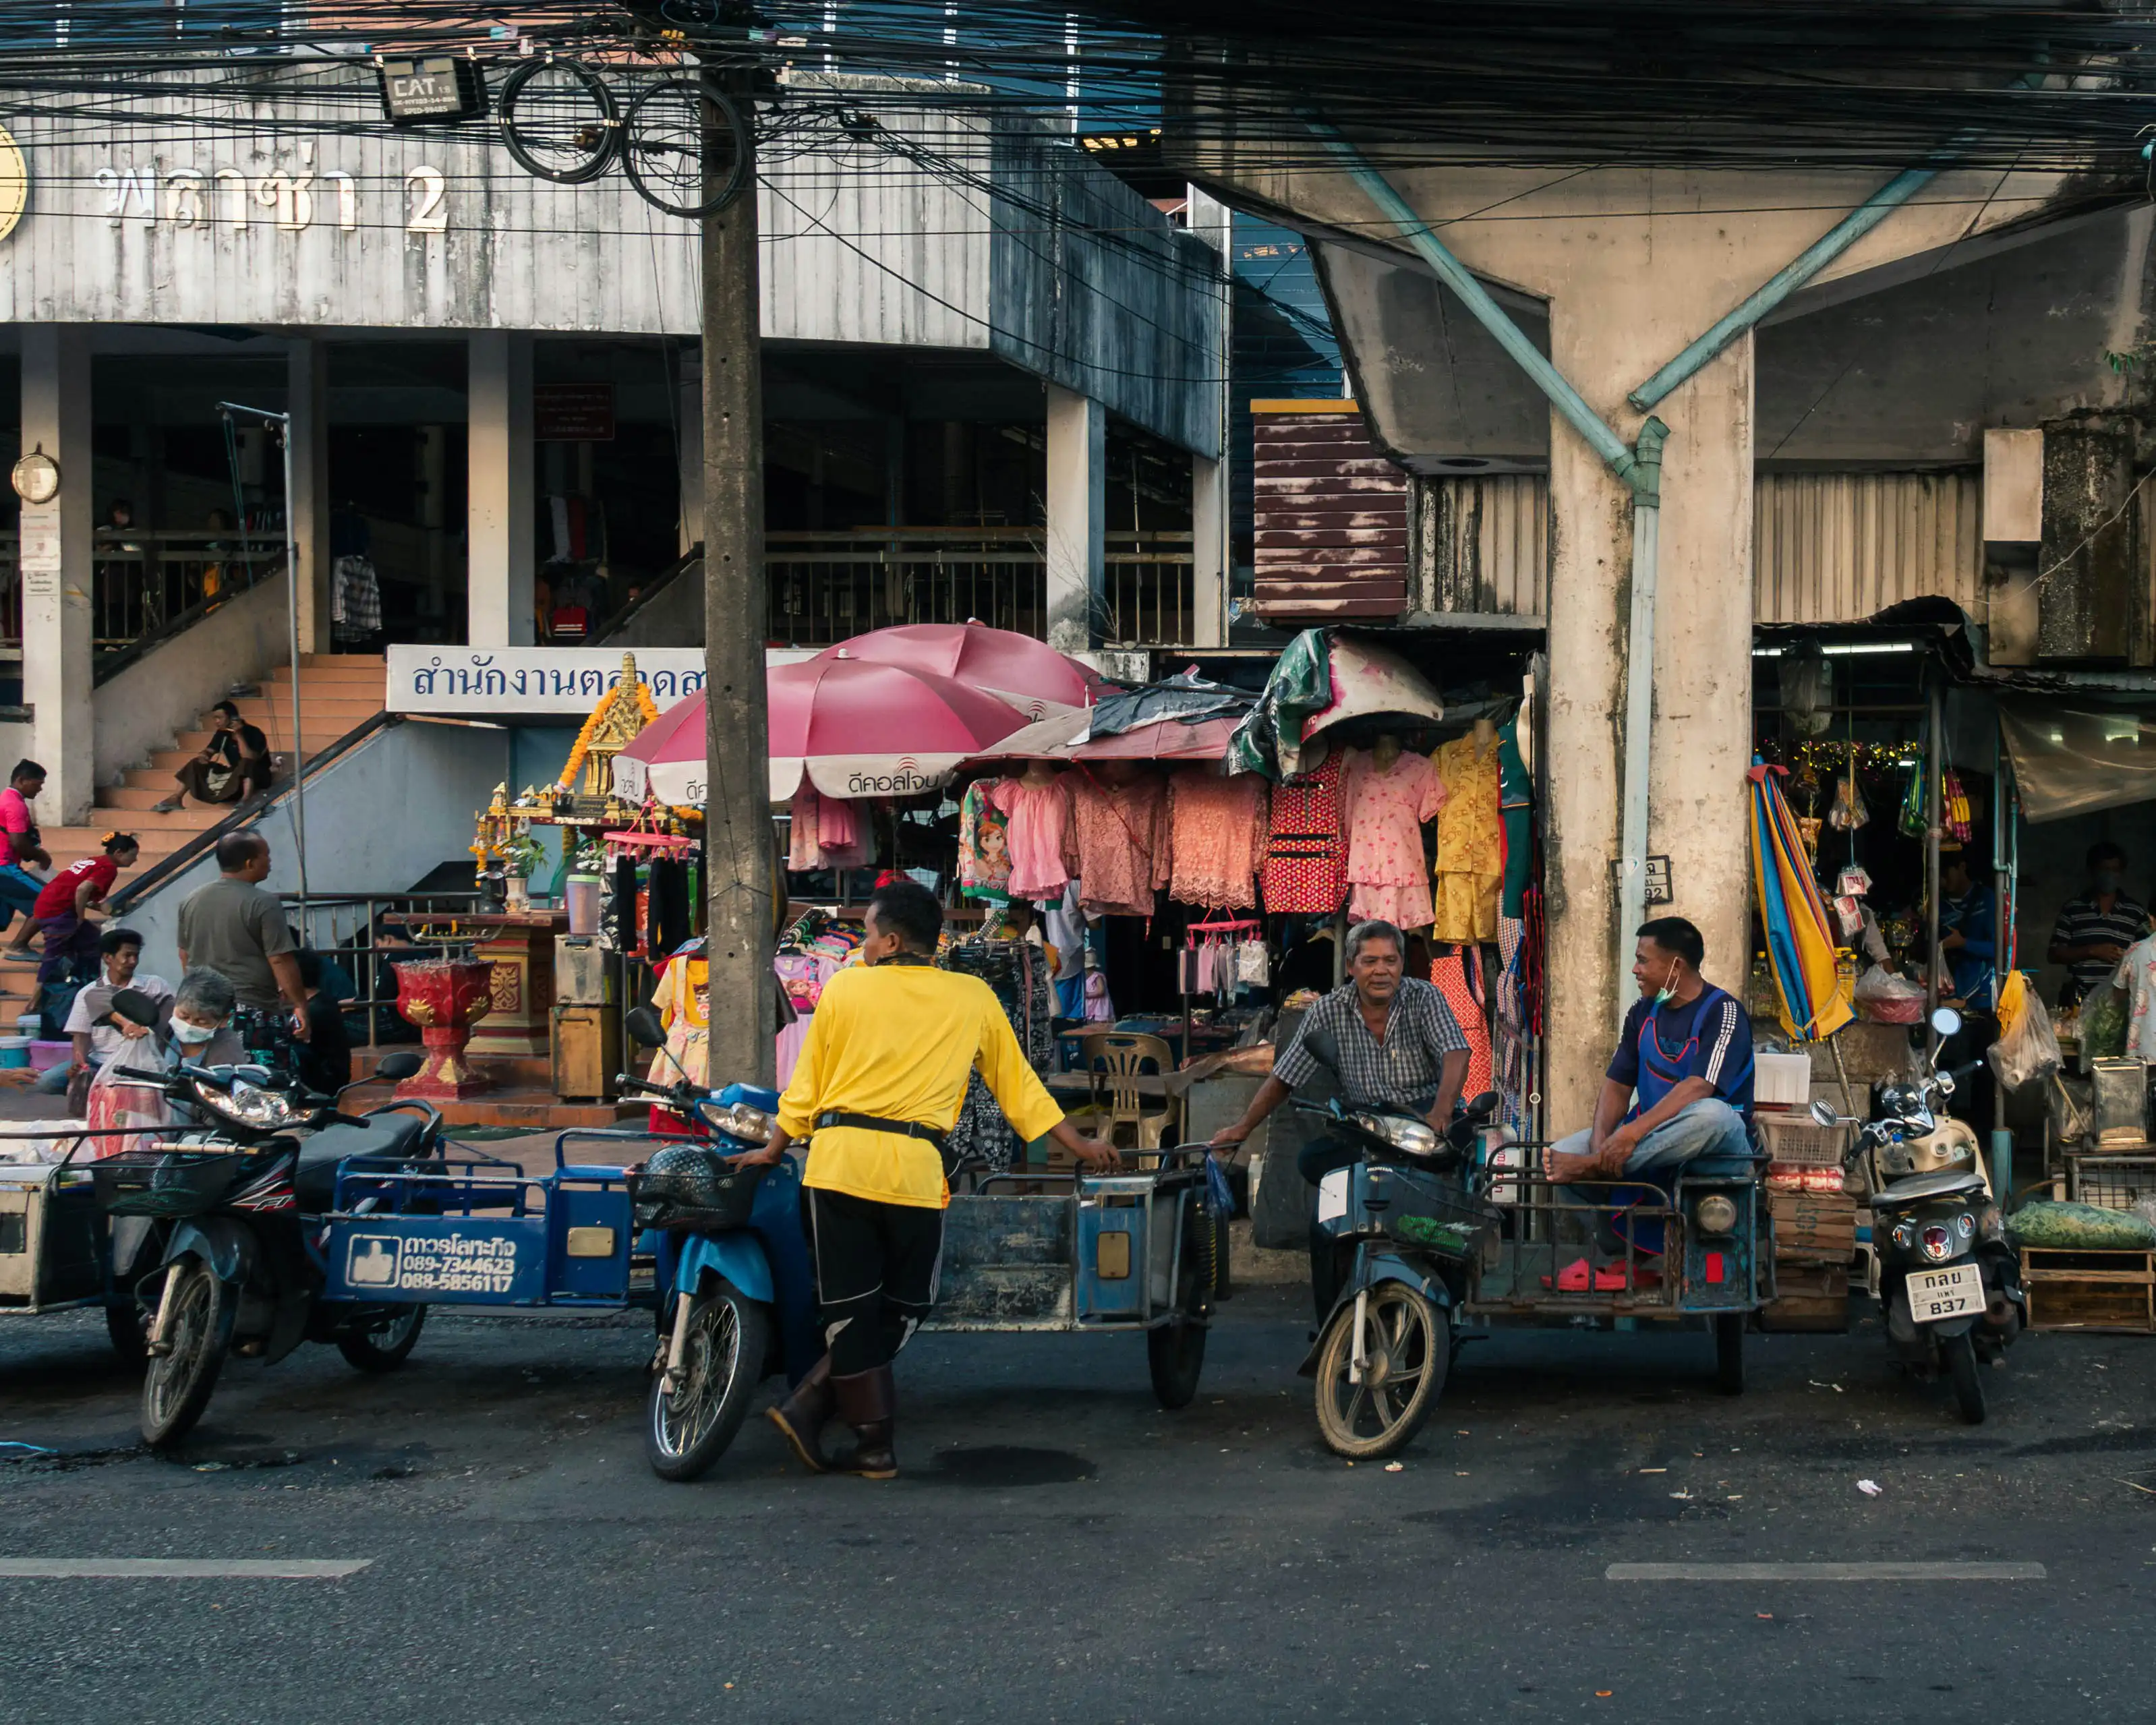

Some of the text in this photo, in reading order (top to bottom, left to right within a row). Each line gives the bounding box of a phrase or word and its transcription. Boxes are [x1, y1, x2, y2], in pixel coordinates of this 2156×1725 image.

[394, 78, 436, 96] CAT
[94, 141, 448, 233] พลาซ่า 2
[403, 1255, 515, 1275] 089-7344623
[401, 1272, 513, 1292] 088-5856117
[1930, 1298, 1966, 1315] 837
